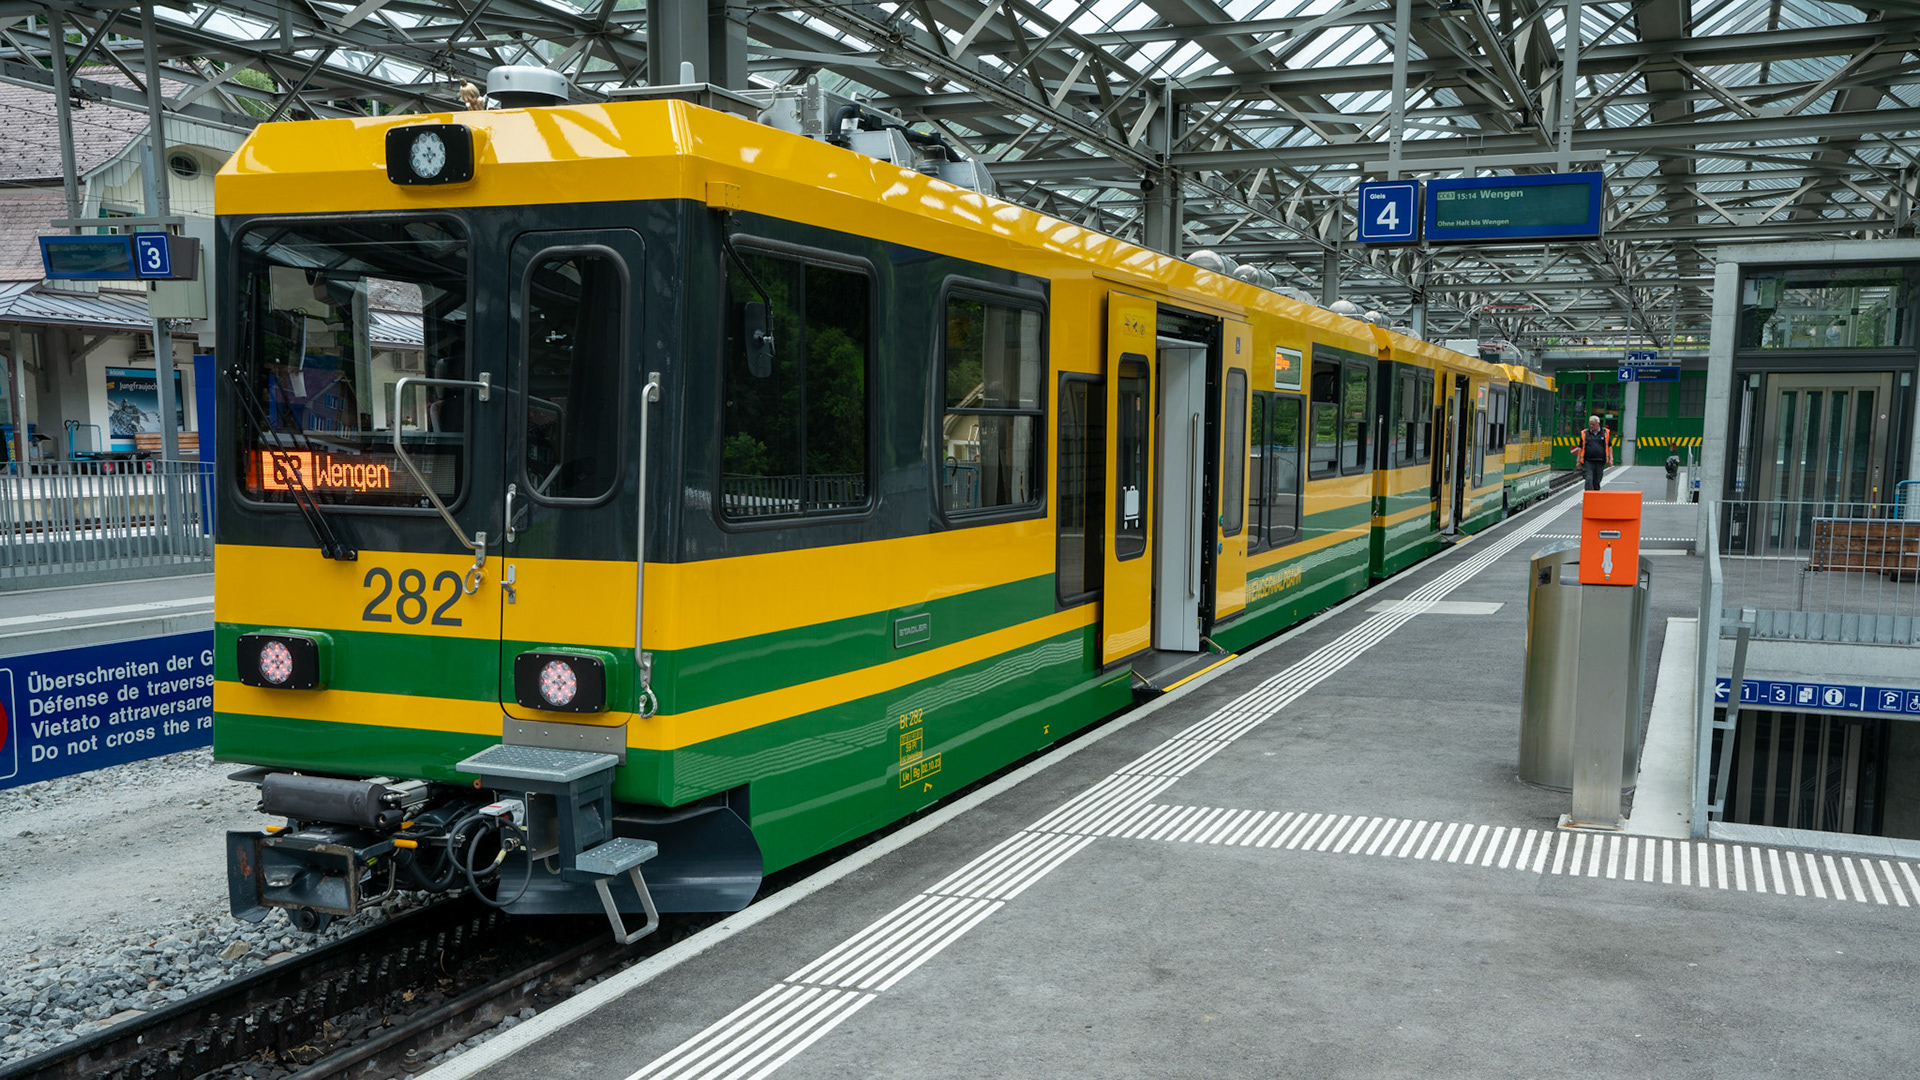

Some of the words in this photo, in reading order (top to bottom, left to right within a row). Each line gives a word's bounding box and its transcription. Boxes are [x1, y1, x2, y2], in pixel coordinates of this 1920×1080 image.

[1480, 189, 1524, 200] Wengen
[1376, 201, 1399, 230] 4
[147, 247, 161, 269] 3
[119, 381, 158, 392] Jungfraujoch
[1621, 371, 1629, 379] 4
[315, 454, 390, 492] Wengen
[362, 566, 463, 627] 282
[899, 623, 928, 637] STADLER
[27, 661, 159, 694] Überschreiten
[166, 655, 194, 672] der
[200, 649, 214, 666] G
[29, 692, 109, 717] Défense
[117, 685, 140, 702] de
[1744, 687, 1750, 699] 1
[1775, 689, 1786, 701] 3
[31, 714, 101, 740] Vietato
[109, 695, 212, 726] attraversare
[909, 708, 923, 726] 282
[31, 745, 59, 763] Do
[67, 735, 98, 756] not
[106, 727, 156, 748] cross
[164, 719, 190, 736] the
